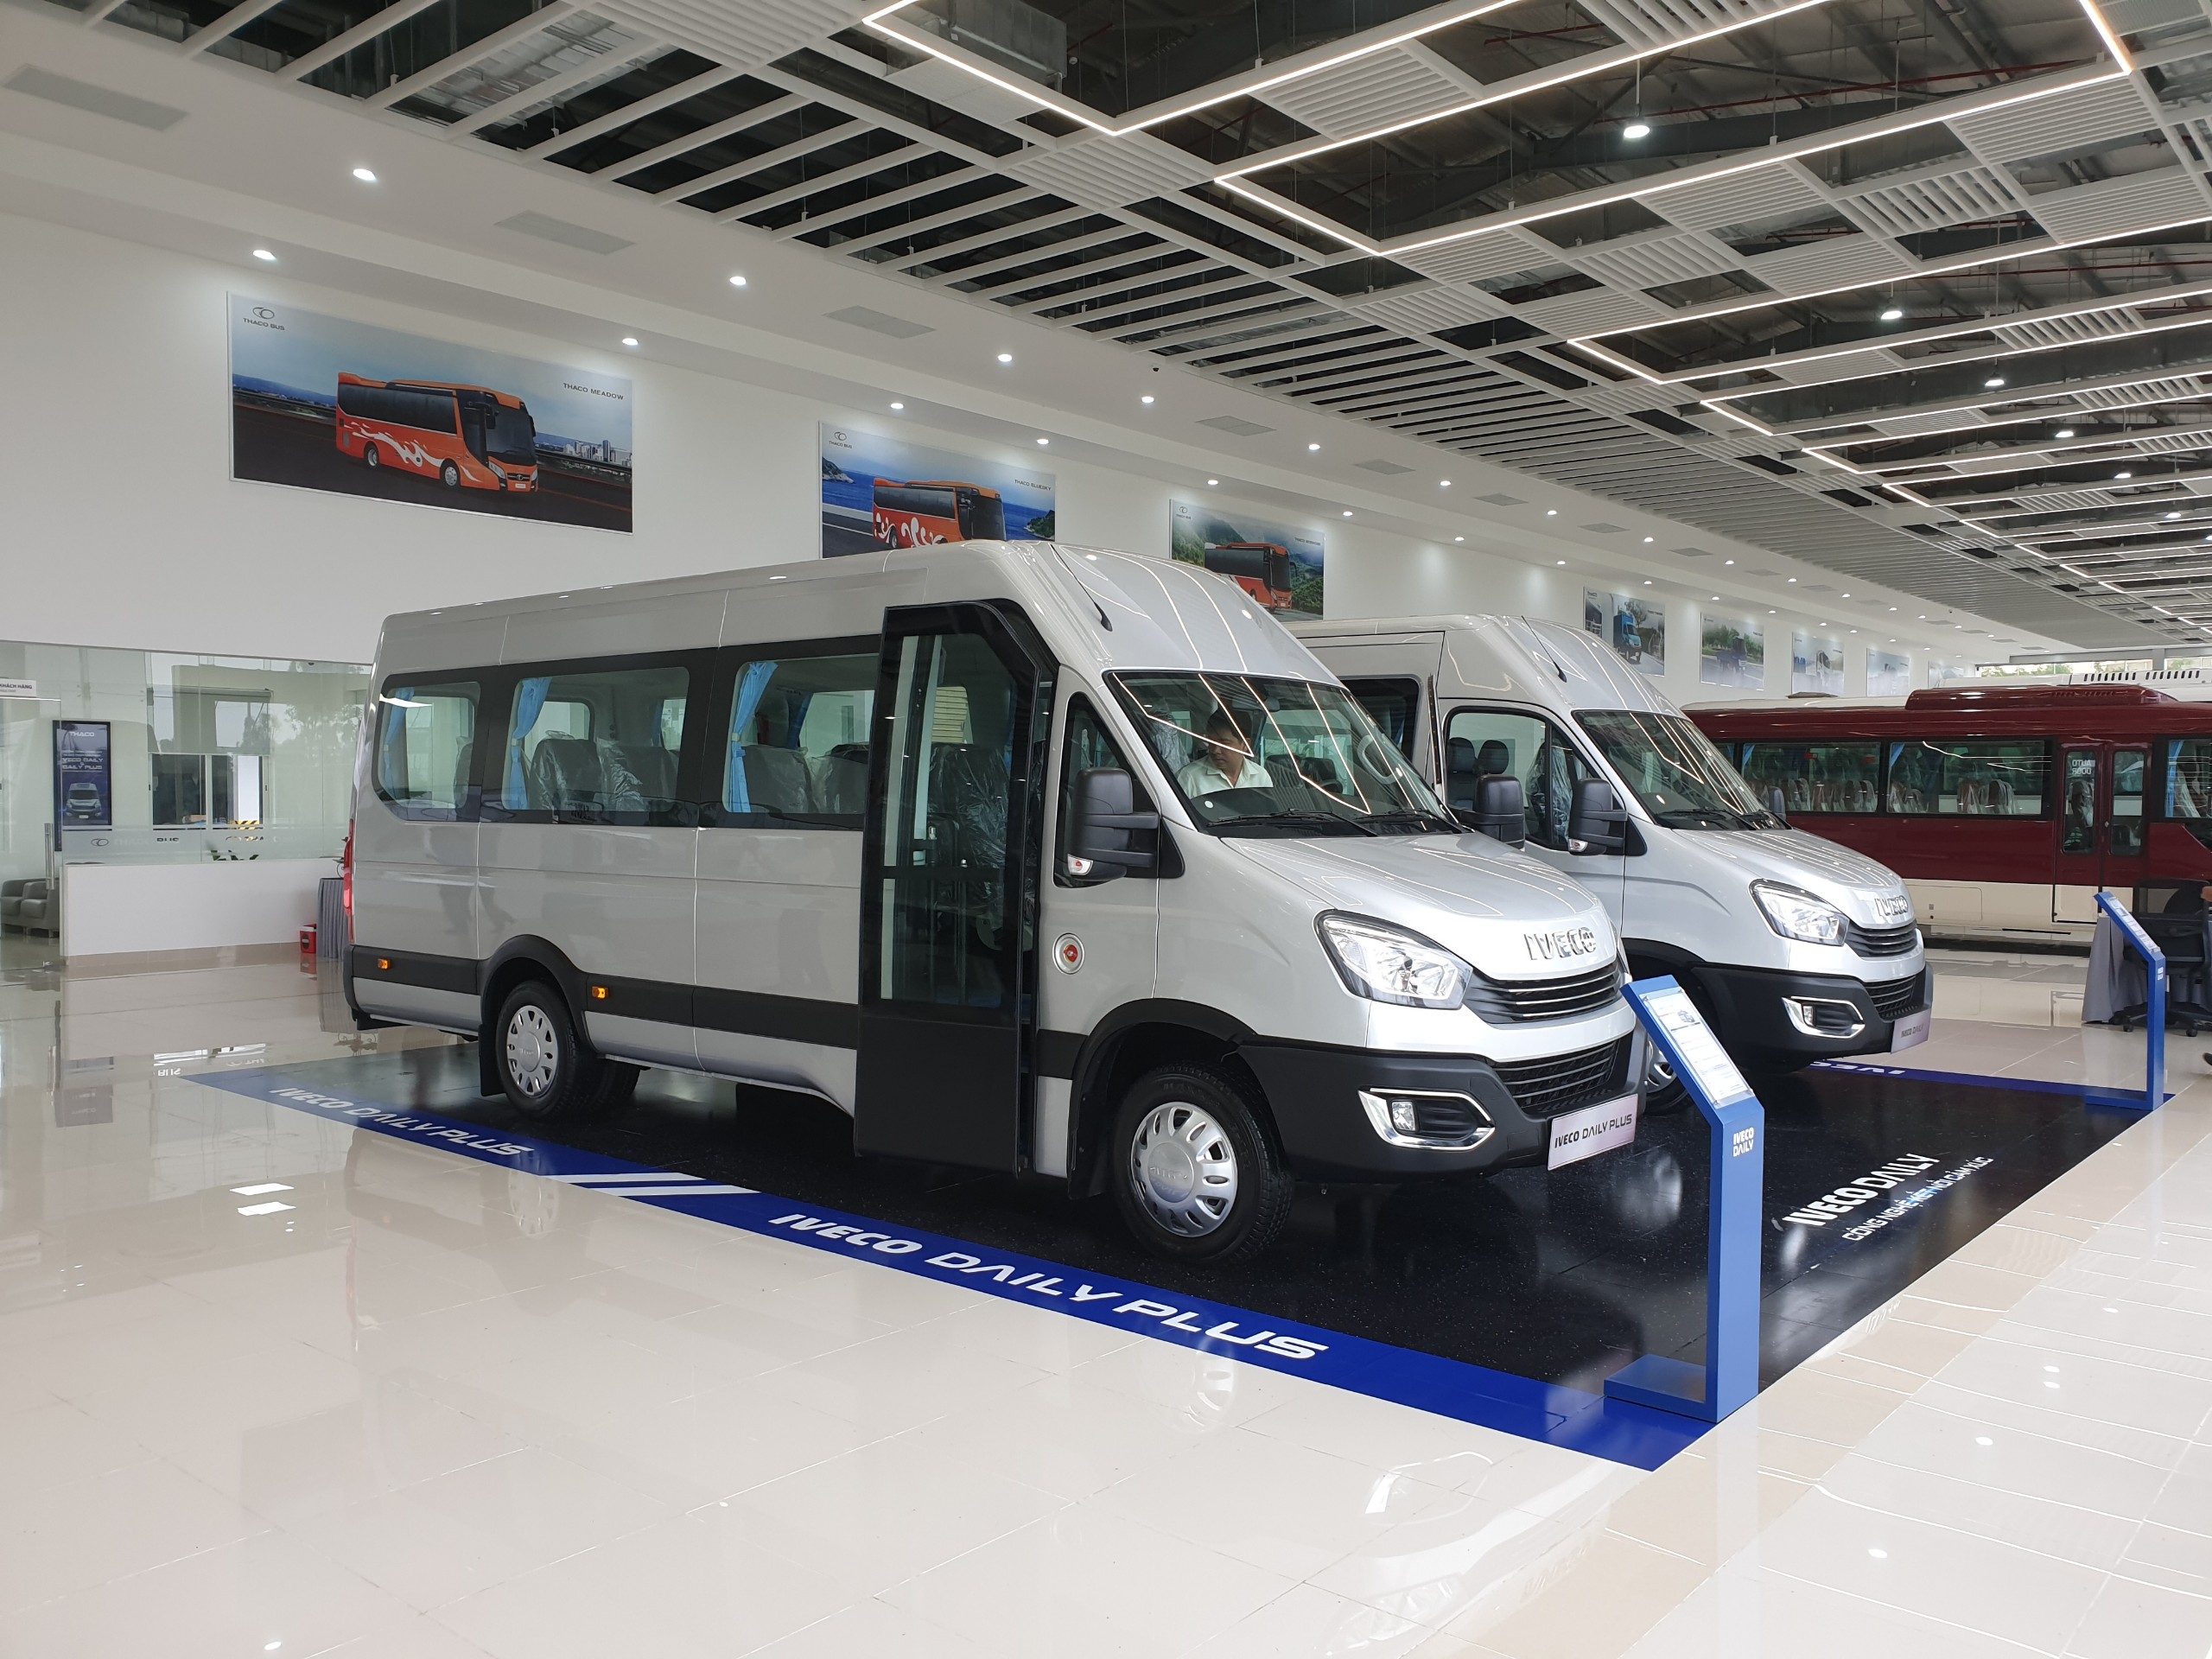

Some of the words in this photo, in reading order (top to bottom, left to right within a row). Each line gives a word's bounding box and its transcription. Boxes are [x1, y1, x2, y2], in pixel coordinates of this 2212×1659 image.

[243, 317, 269, 327] THACO
[563, 382, 588, 393] THACO
[590, 388, 624, 401] MEADOW
[1874, 895, 1909, 917] IVECO
[1523, 926, 1597, 960] IVECO
[269, 1087, 354, 1109] IVECO
[343, 1107, 439, 1131] DAILY
[426, 1128, 535, 1156] PLUS
[1554, 1130, 1580, 1148] IVECO
[1581, 1121, 1608, 1140] DAILY
[1608, 1114, 1632, 1130] PLUS
[1732, 1127, 1754, 1146] IVECO
[1732, 1139, 1754, 1157] DAILY
[1782, 1187, 1878, 1226] IVECO
[1850, 1153, 1941, 1189] DAILY
[1841, 1217, 1889, 1242] CÔNG
[769, 1214, 923, 1254] IVECO
[925, 1252, 1124, 1301] DAILY
[1114, 1299, 1329, 1360] PLUS
